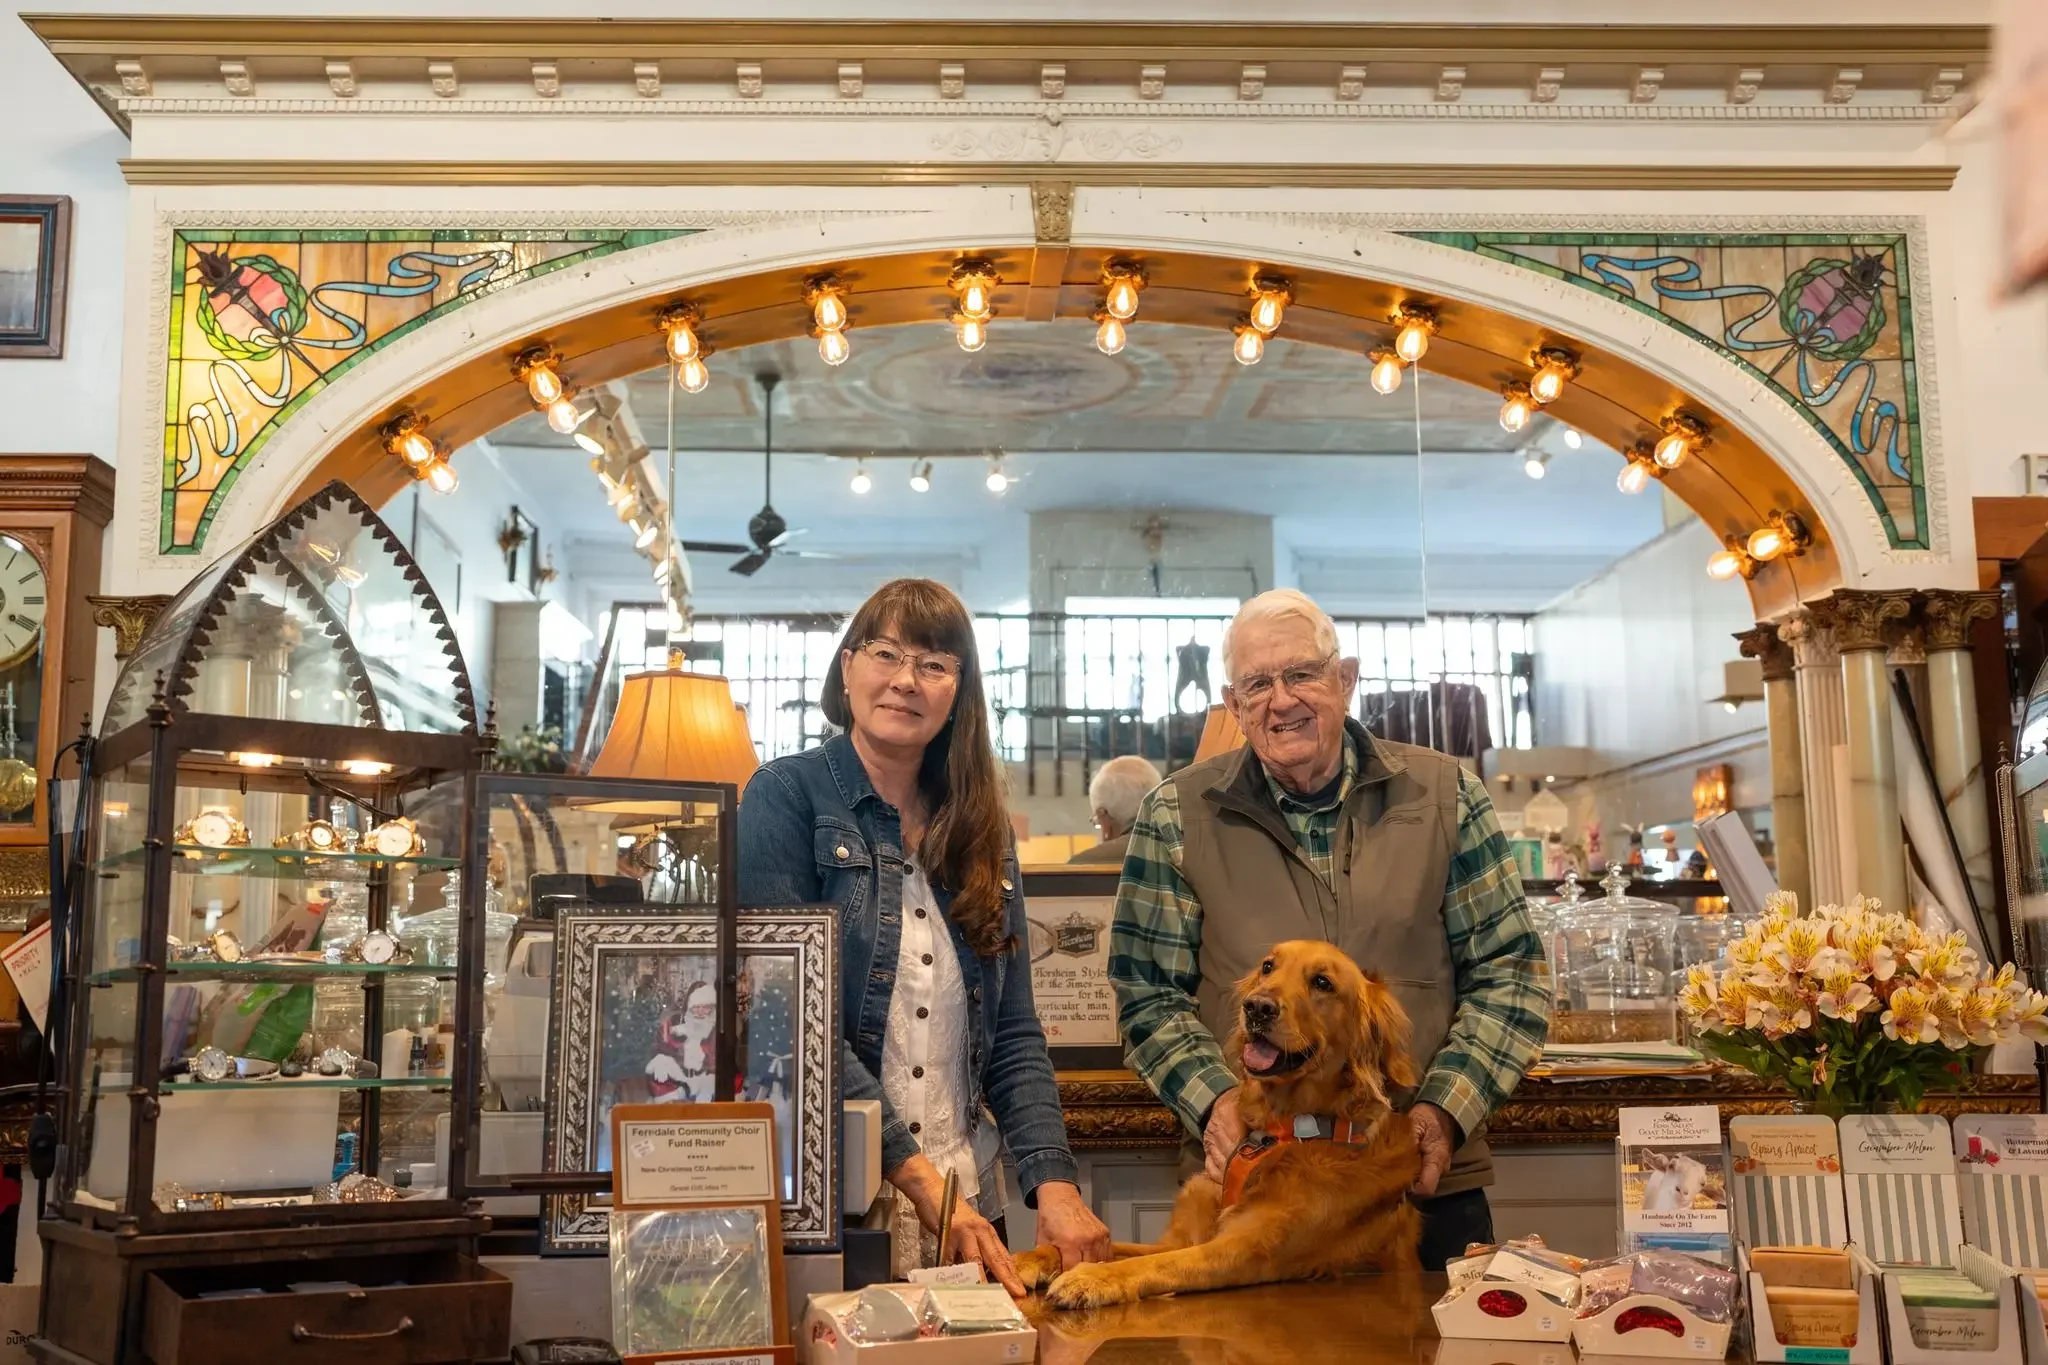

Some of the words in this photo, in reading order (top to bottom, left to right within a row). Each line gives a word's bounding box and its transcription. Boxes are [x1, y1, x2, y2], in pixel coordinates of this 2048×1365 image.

[11, 947, 39, 971] PRIORITY
[1033, 967, 1077, 978] Florsheim
[1034, 979, 1044, 989] of
[1048, 978, 1062, 989] the
[1065, 978, 1093, 989] Times
[1078, 989, 1092, 999] for
[1094, 988, 1111, 999] the
[1036, 1001, 1080, 1011] particular
[1087, 1002, 1111, 1011] man,
[1070, 1012, 1086, 1021] who
[1087, 1013, 1110, 1021] cares
[632, 1127, 676, 1137] Ferndale
[678, 1127, 732, 1139] Community
[734, 1126, 761, 1135] Choir
[668, 1139, 693, 1148] Fund
[695, 1139, 726, 1148] Raiser
[1858, 1140, 1903, 1154] Cucumber
[1904, 1140, 1937, 1154] Melon
[1750, 1141, 1783, 1158] Spring
[1660, 1221, 1676, 1229] Since
[1652, 1276, 1705, 1296] Cherish
